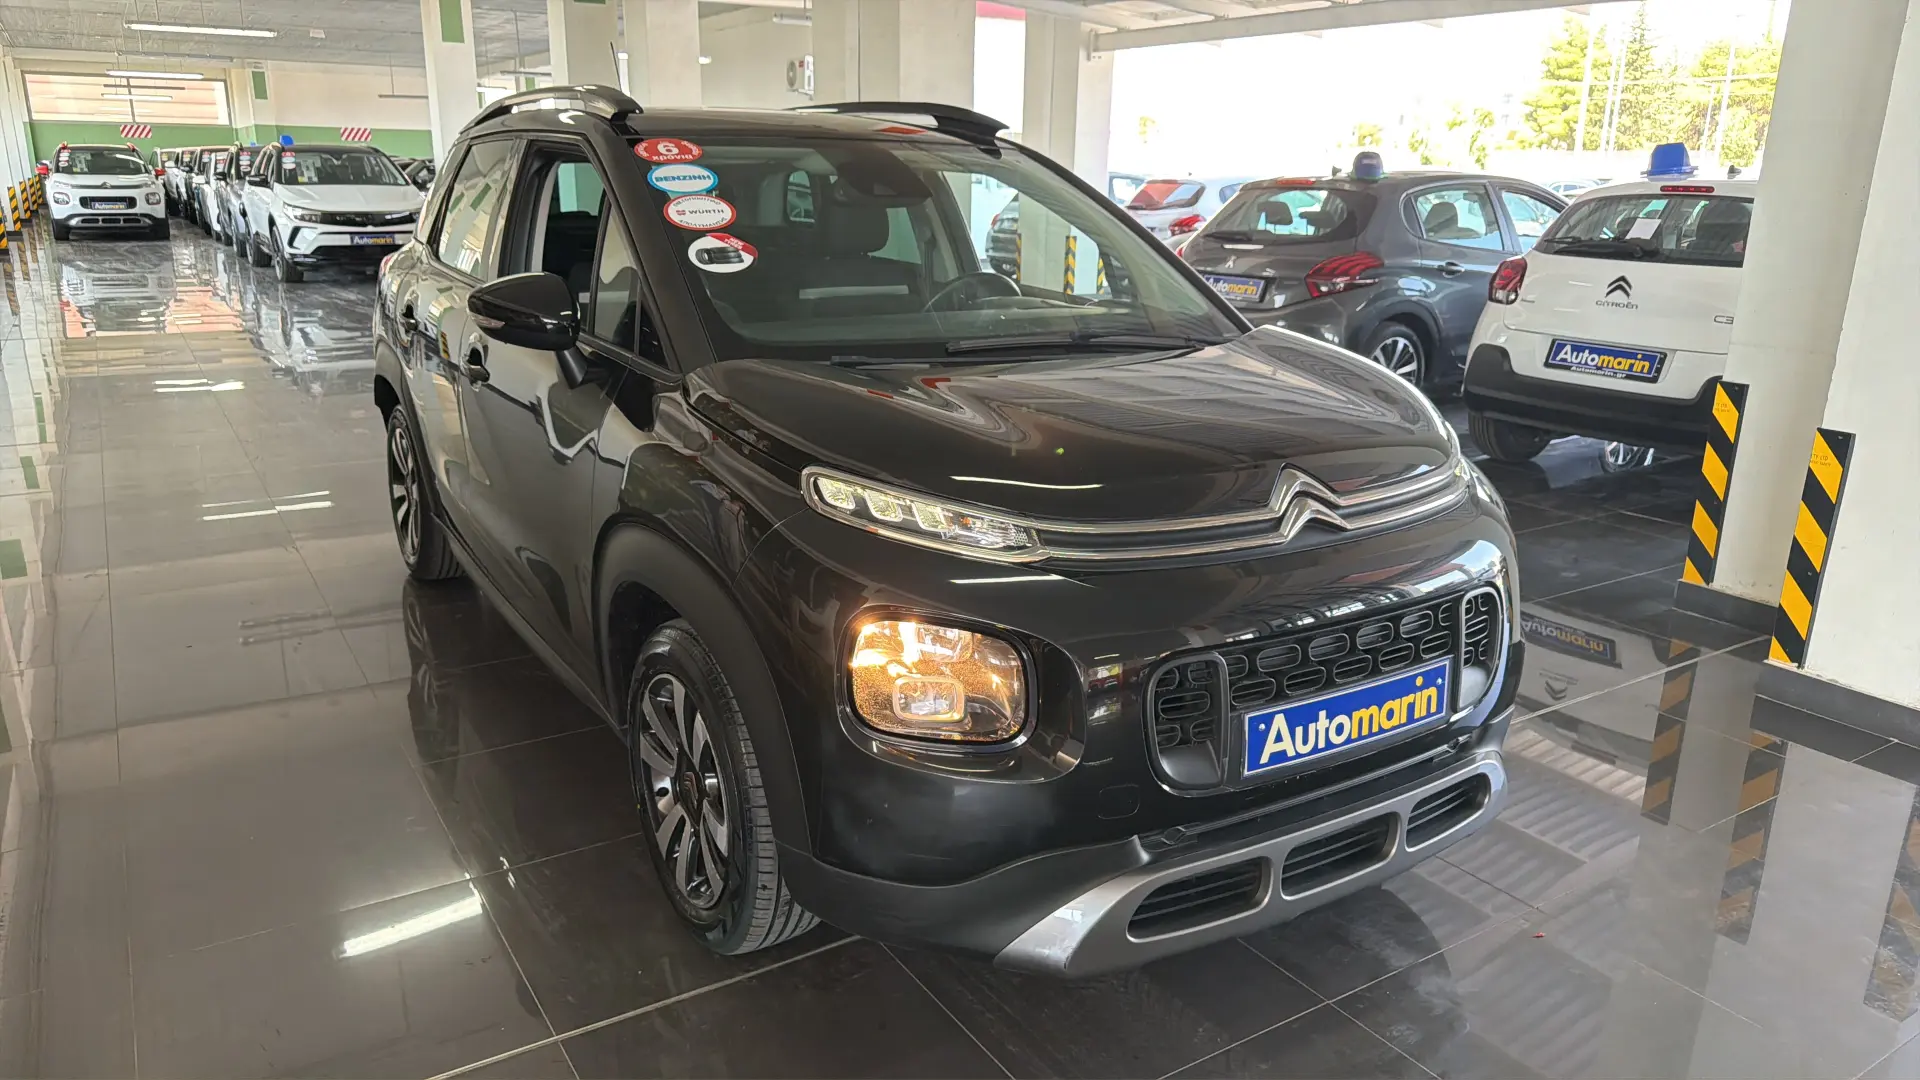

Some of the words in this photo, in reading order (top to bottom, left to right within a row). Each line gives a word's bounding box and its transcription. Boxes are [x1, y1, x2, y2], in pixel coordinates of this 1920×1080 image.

[657, 142, 679, 155] 6
[353, 236, 393, 245] Automarin
[1713, 315, 1735, 325] C3
[1555, 344, 1650, 374] Automarin
[1259, 675, 1438, 765] Automarin
